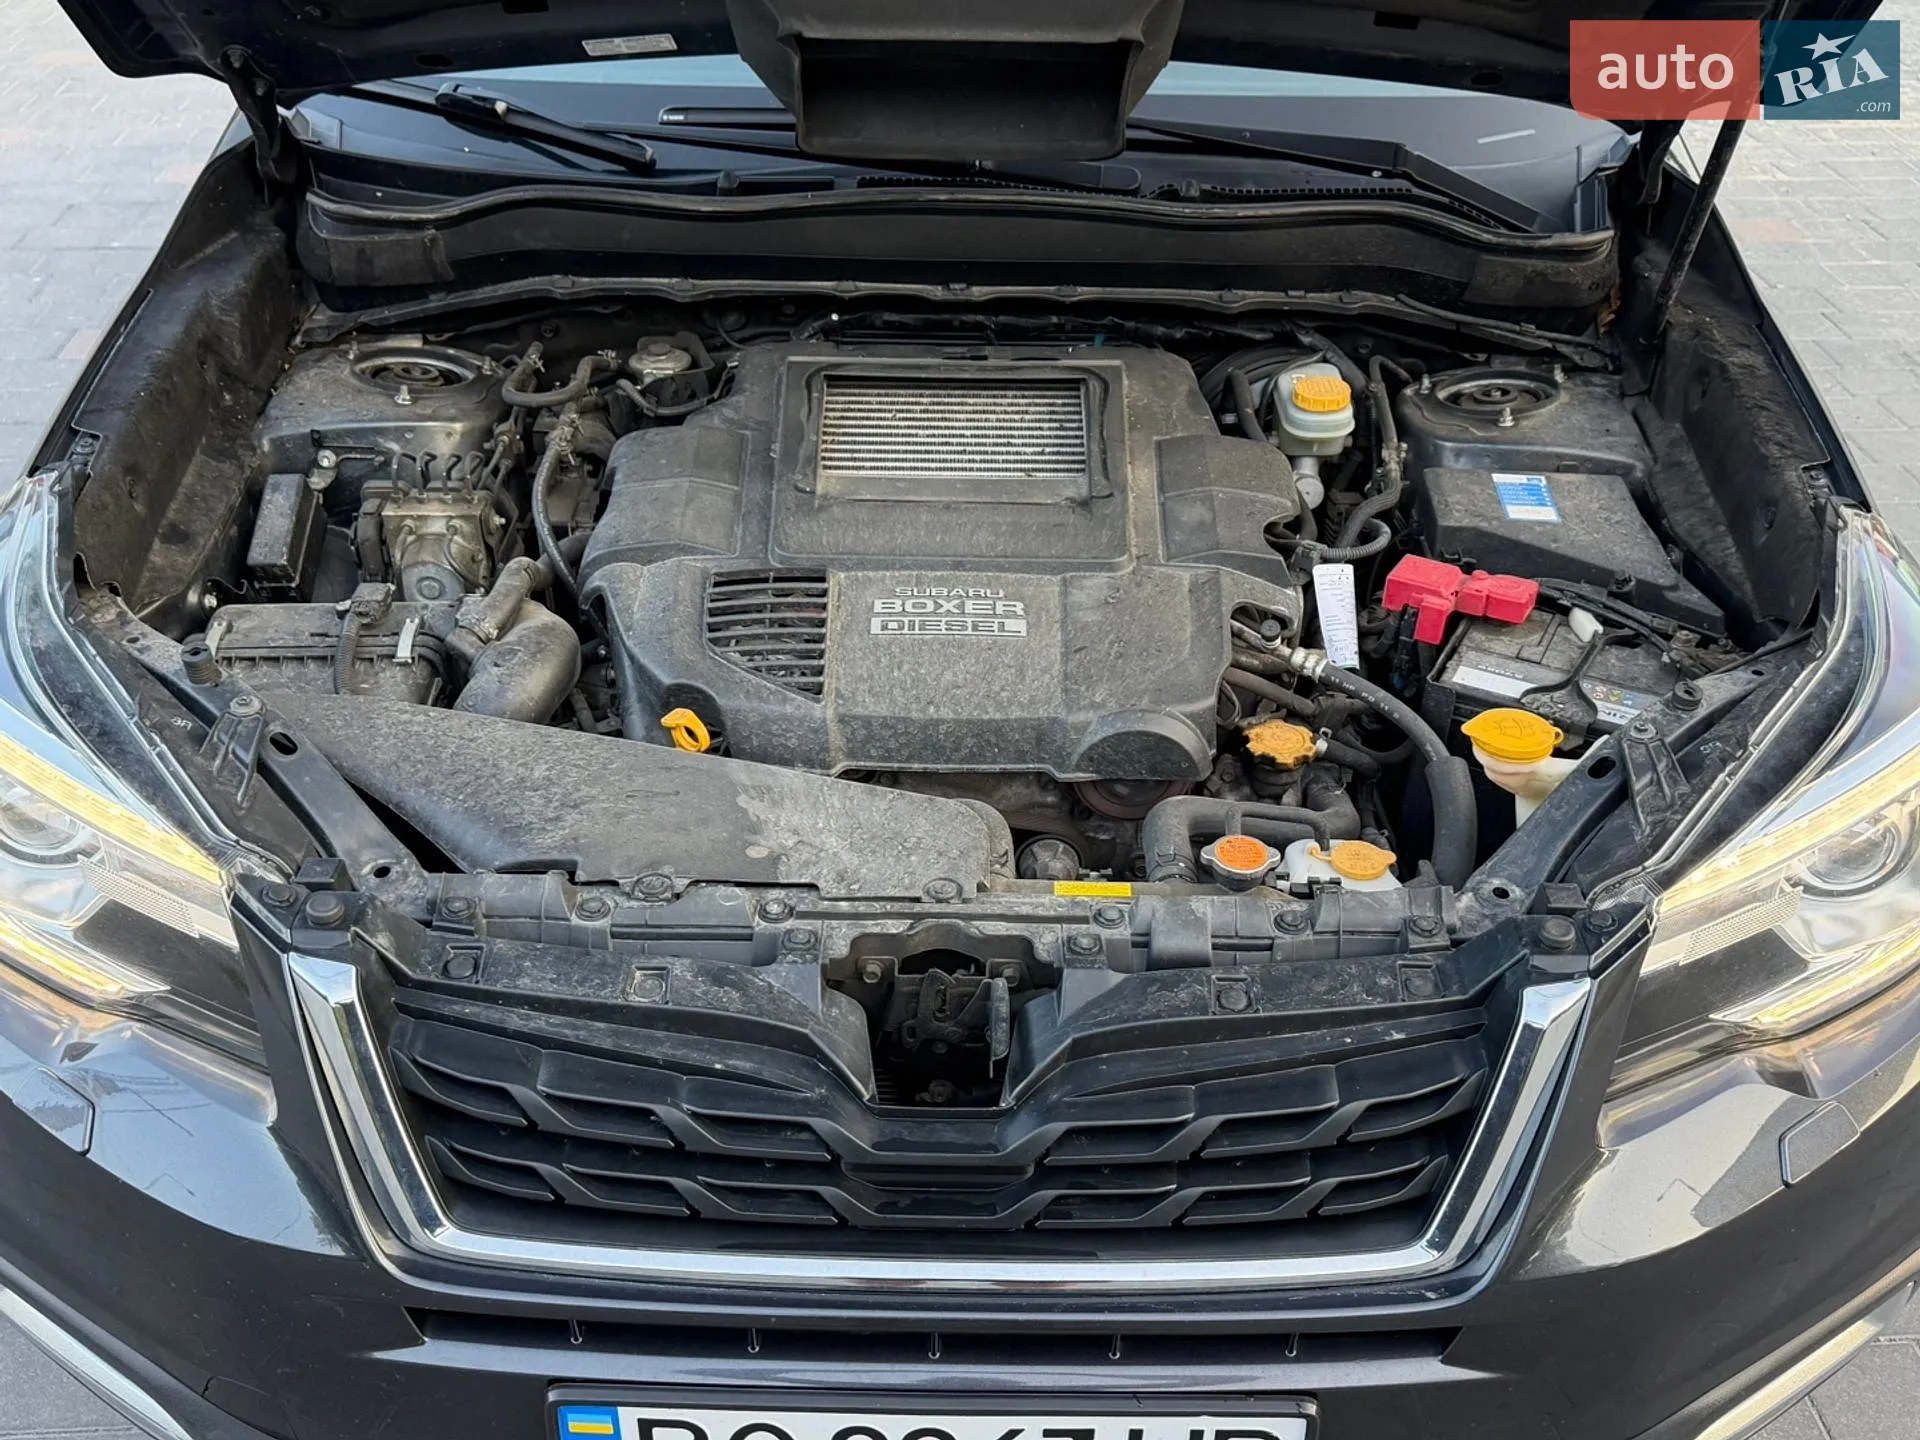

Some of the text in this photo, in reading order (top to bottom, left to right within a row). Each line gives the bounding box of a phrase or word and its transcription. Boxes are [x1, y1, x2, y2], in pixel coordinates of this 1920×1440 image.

[894, 586, 1005, 598] SUBARU
[873, 598, 1025, 617] BOXER
[879, 618, 1023, 634] DIESEL
